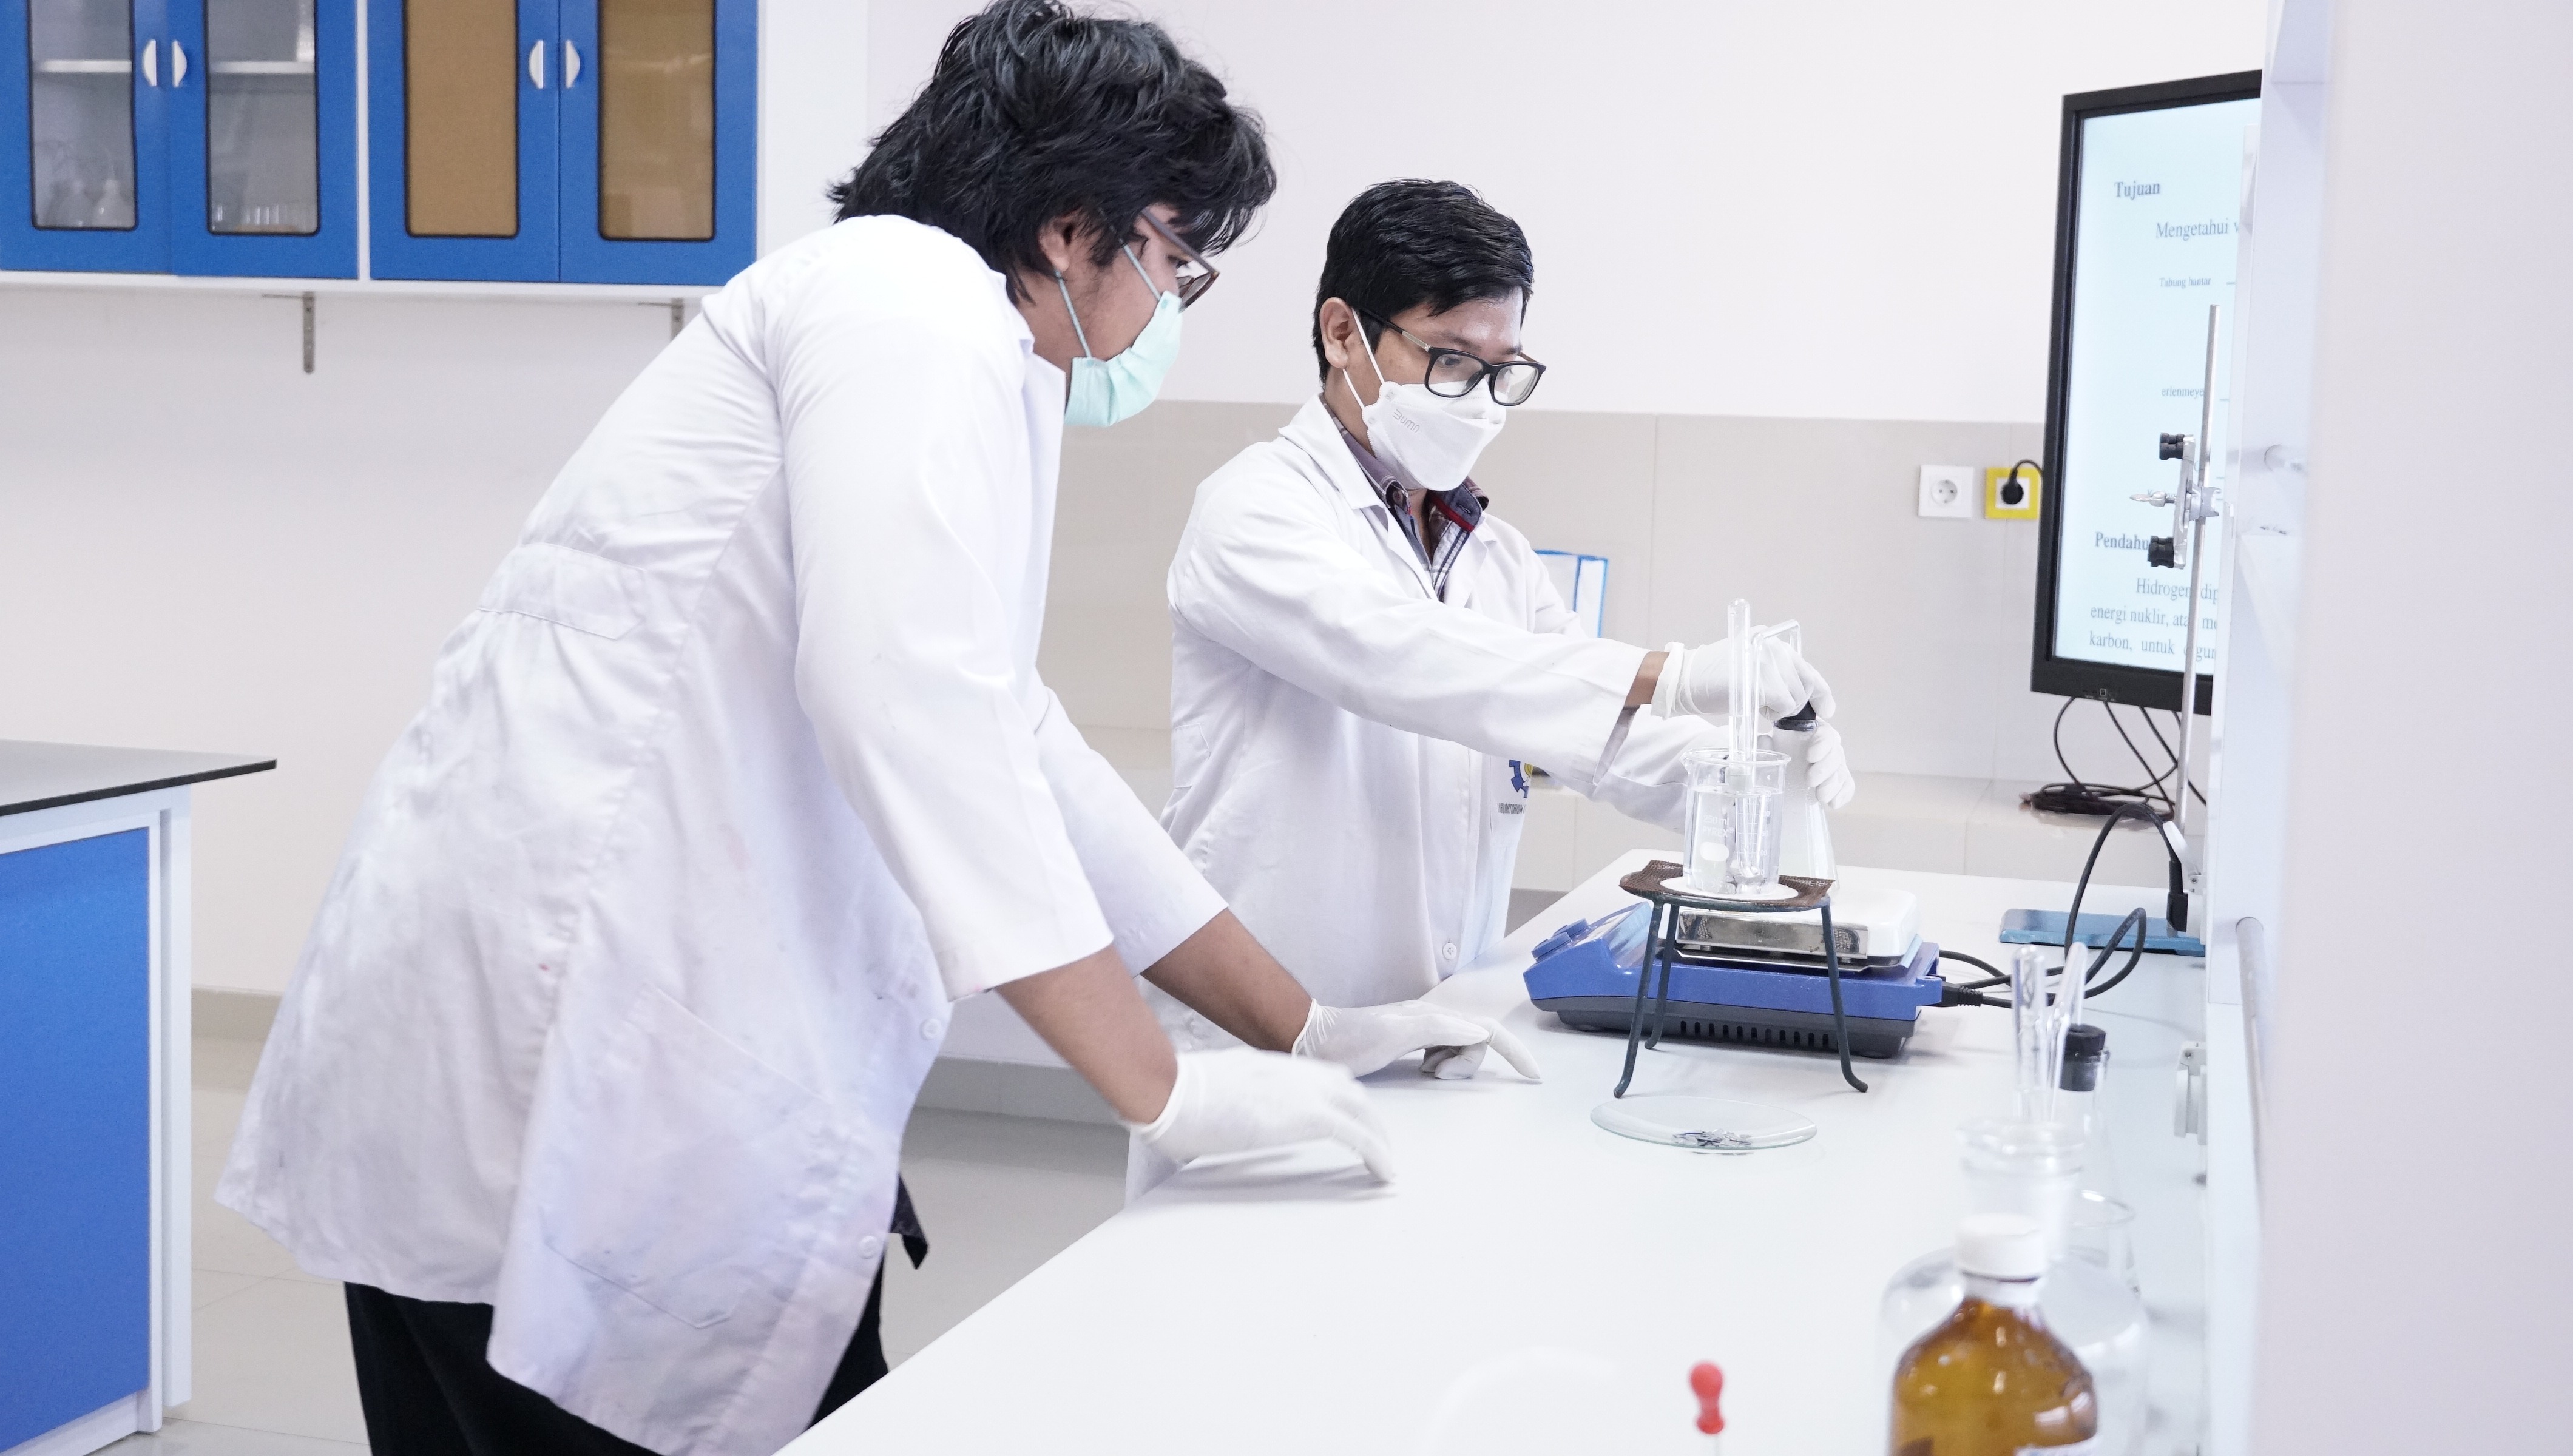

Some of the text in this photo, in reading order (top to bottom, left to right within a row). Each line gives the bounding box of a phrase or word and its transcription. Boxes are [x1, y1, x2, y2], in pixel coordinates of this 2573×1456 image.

[2114, 180, 2160, 200] Tujuan
[2155, 218, 2229, 241] Mengetahui
[2159, 277, 2186, 289] Tabung
[2161, 385, 2204, 399] erlenmeye
[2095, 531, 2149, 550] Pendahu
[2091, 605, 2126, 624] energi
[2130, 608, 2169, 627] nuklir,
[2172, 615, 2189, 627] ata
[2089, 630, 2132, 652] karbon,
[2141, 639, 2175, 655] untuk
[1703, 814, 1717, 824] 250
